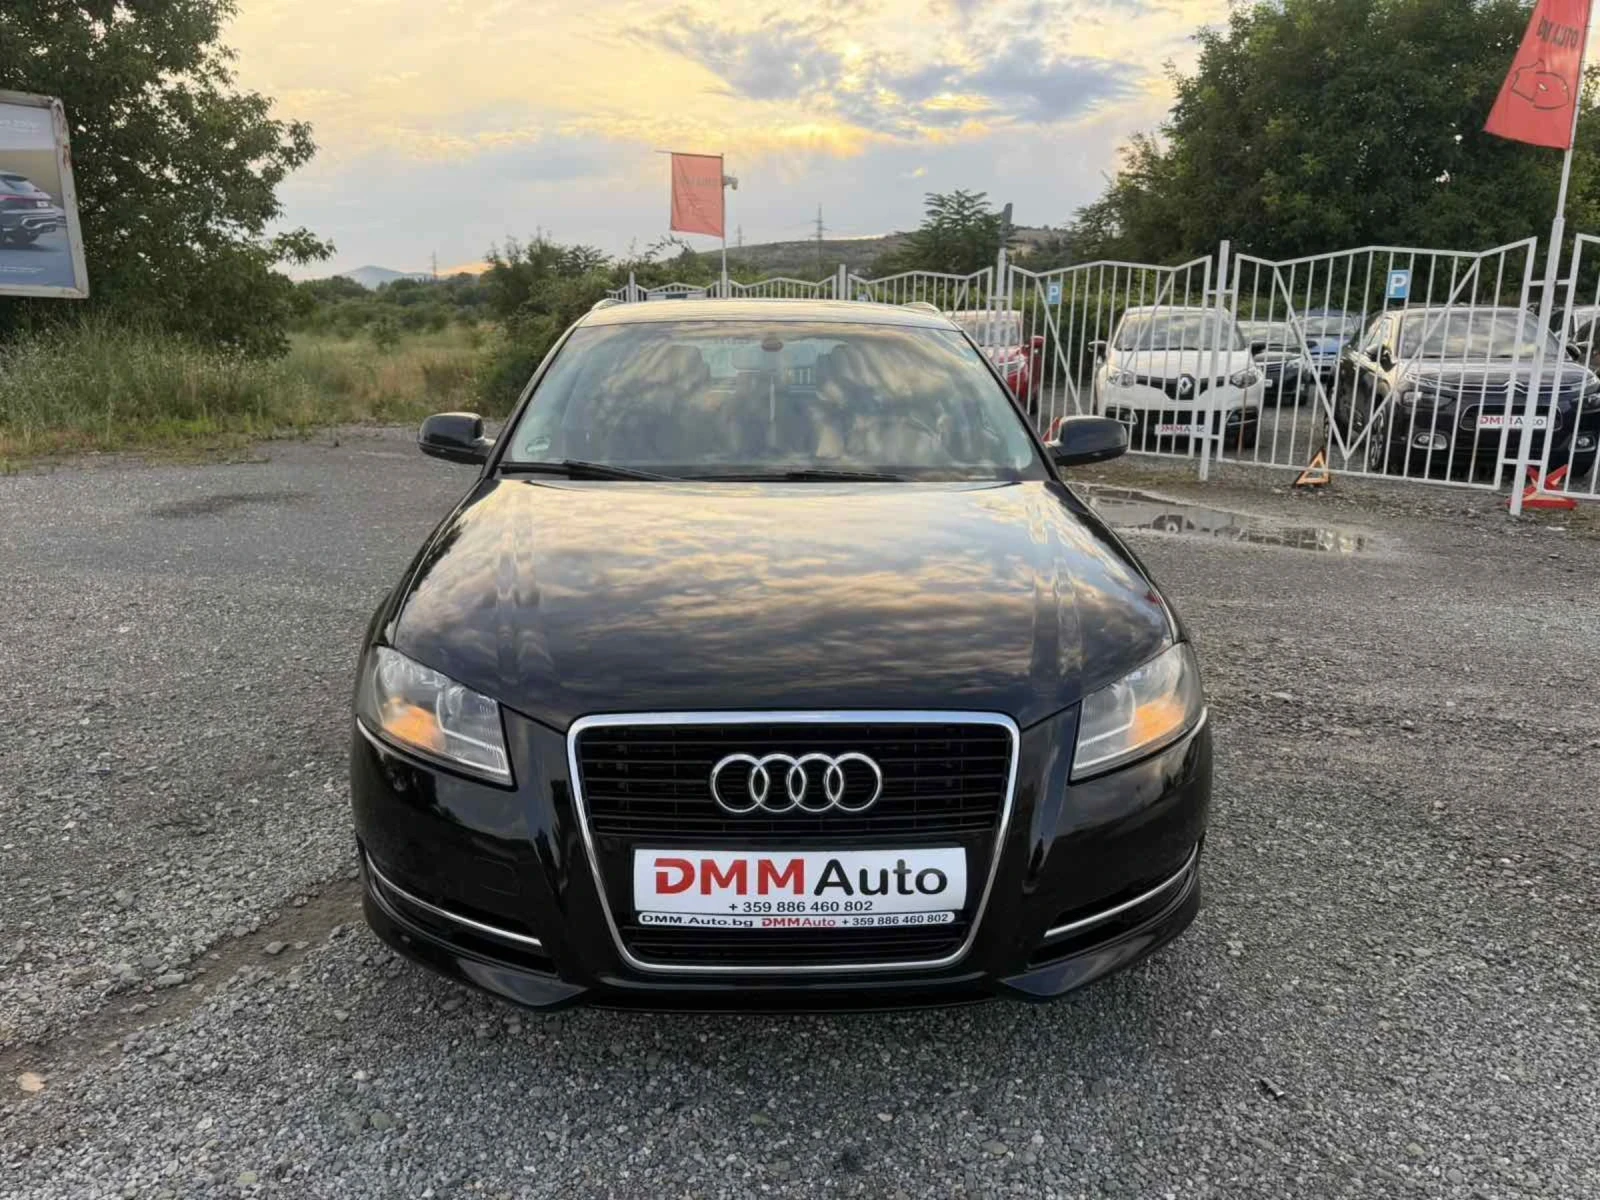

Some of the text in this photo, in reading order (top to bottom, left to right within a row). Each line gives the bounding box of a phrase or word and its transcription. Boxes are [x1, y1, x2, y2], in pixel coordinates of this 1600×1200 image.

[1389, 273, 1407, 295] P
[1048, 286, 1059, 302] P
[743, 902, 772, 913] 359
[777, 902, 806, 913] 886
[810, 902, 840, 913] 460
[844, 901, 873, 912] 802
[641, 914, 754, 928] DMM.Auto.bg
[852, 917, 874, 926] 359
[877, 916, 899, 925] 886
[902, 915, 924, 924] 460
[927, 914, 949, 923] 802
